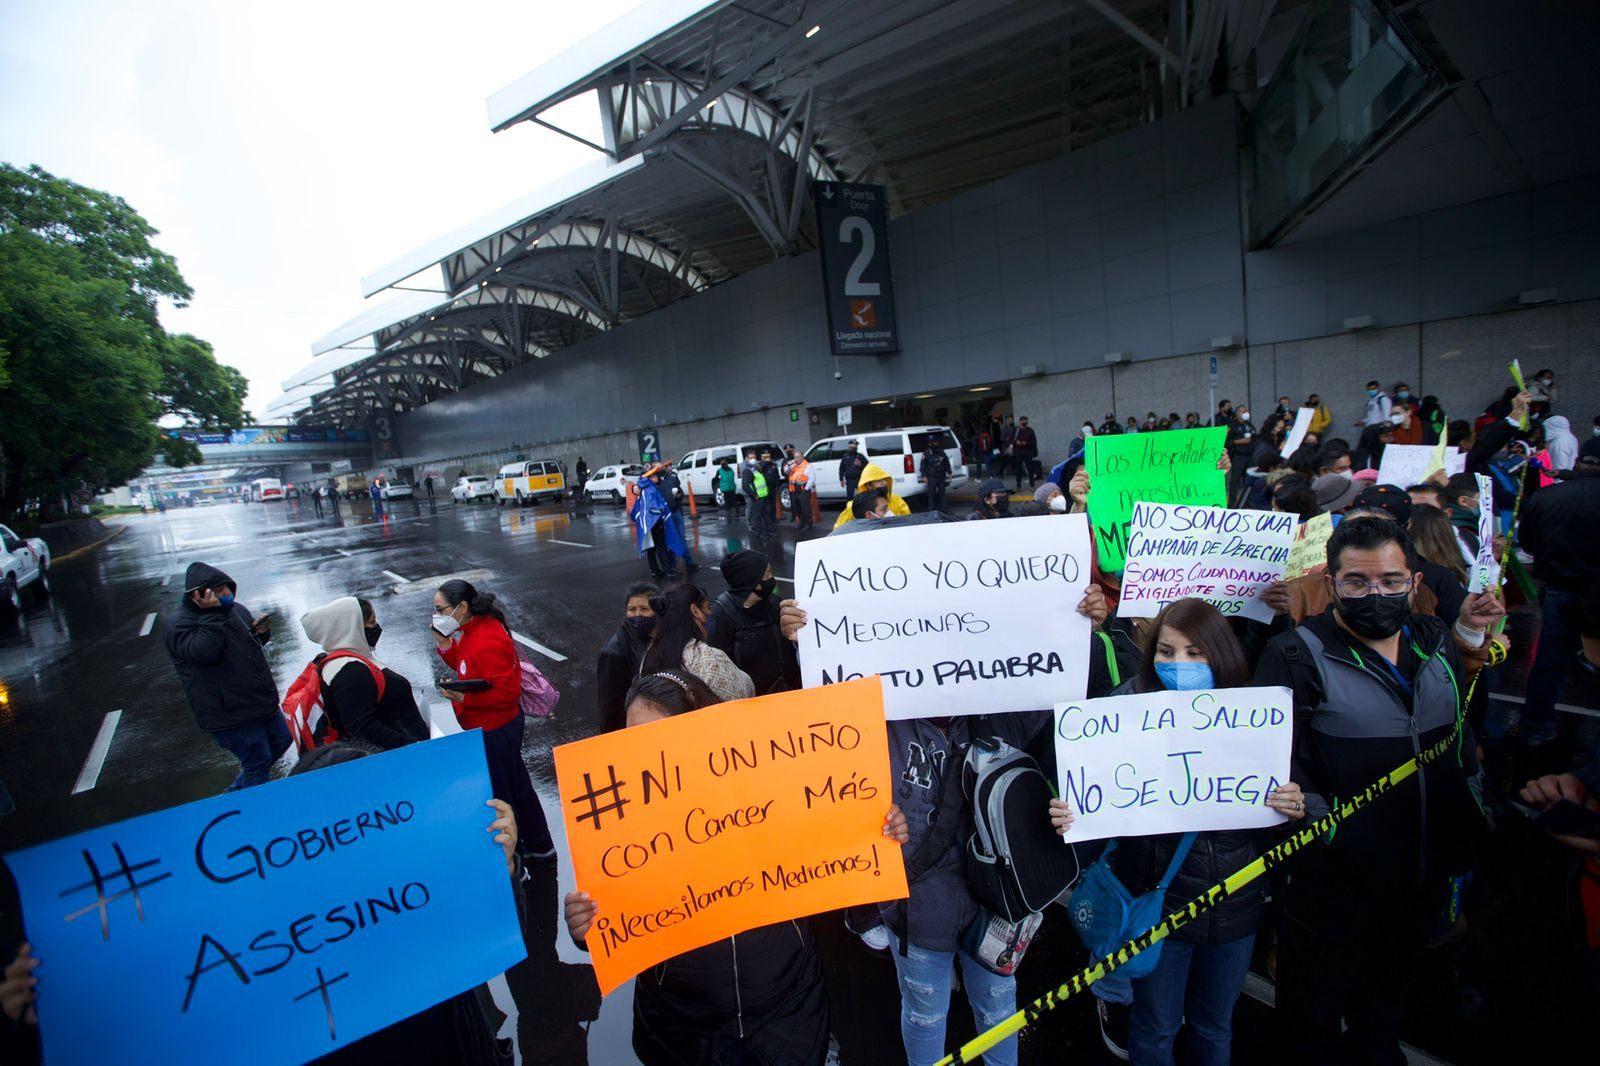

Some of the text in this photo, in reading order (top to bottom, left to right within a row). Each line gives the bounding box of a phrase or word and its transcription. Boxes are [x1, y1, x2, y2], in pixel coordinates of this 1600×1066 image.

[843, 188, 875, 200] Puerta
[850, 201, 870, 210] Door
[839, 215, 881, 296] 2
[836, 330, 891, 341] Llegada nacional
[376, 417, 391, 439] 3
[643, 434, 657, 453] 2
[1094, 437, 1217, 477] Los Hospitales
[1132, 504, 1292, 534] NO SOMOS UNA
[1128, 531, 1198, 558] CAMPAÑA
[1201, 540, 1222, 556] DE
[1221, 535, 1289, 565] DERECHA,
[809, 553, 1079, 598] AMLO YO QUIERO
[1125, 562, 1281, 585] SOMOS CIUDADANOS
[1224, 585, 1257, 598] SUS
[814, 612, 990, 648] MEDICINAS
[876, 668, 923, 688] TU
[932, 651, 1064, 686] PALABRA
[1058, 693, 1285, 741] CON LA SALUD
[708, 740, 757, 777] UN
[771, 722, 860, 761] NIÑO
[1065, 751, 1281, 815] NO SE JUEGA
[685, 800, 775, 844] Cancer
[804, 772, 878, 809] MÁS
[195, 800, 415, 884] GOBIERNO
[762, 844, 881, 892] Medicinas!
[181, 881, 430, 1012] ASESINO
